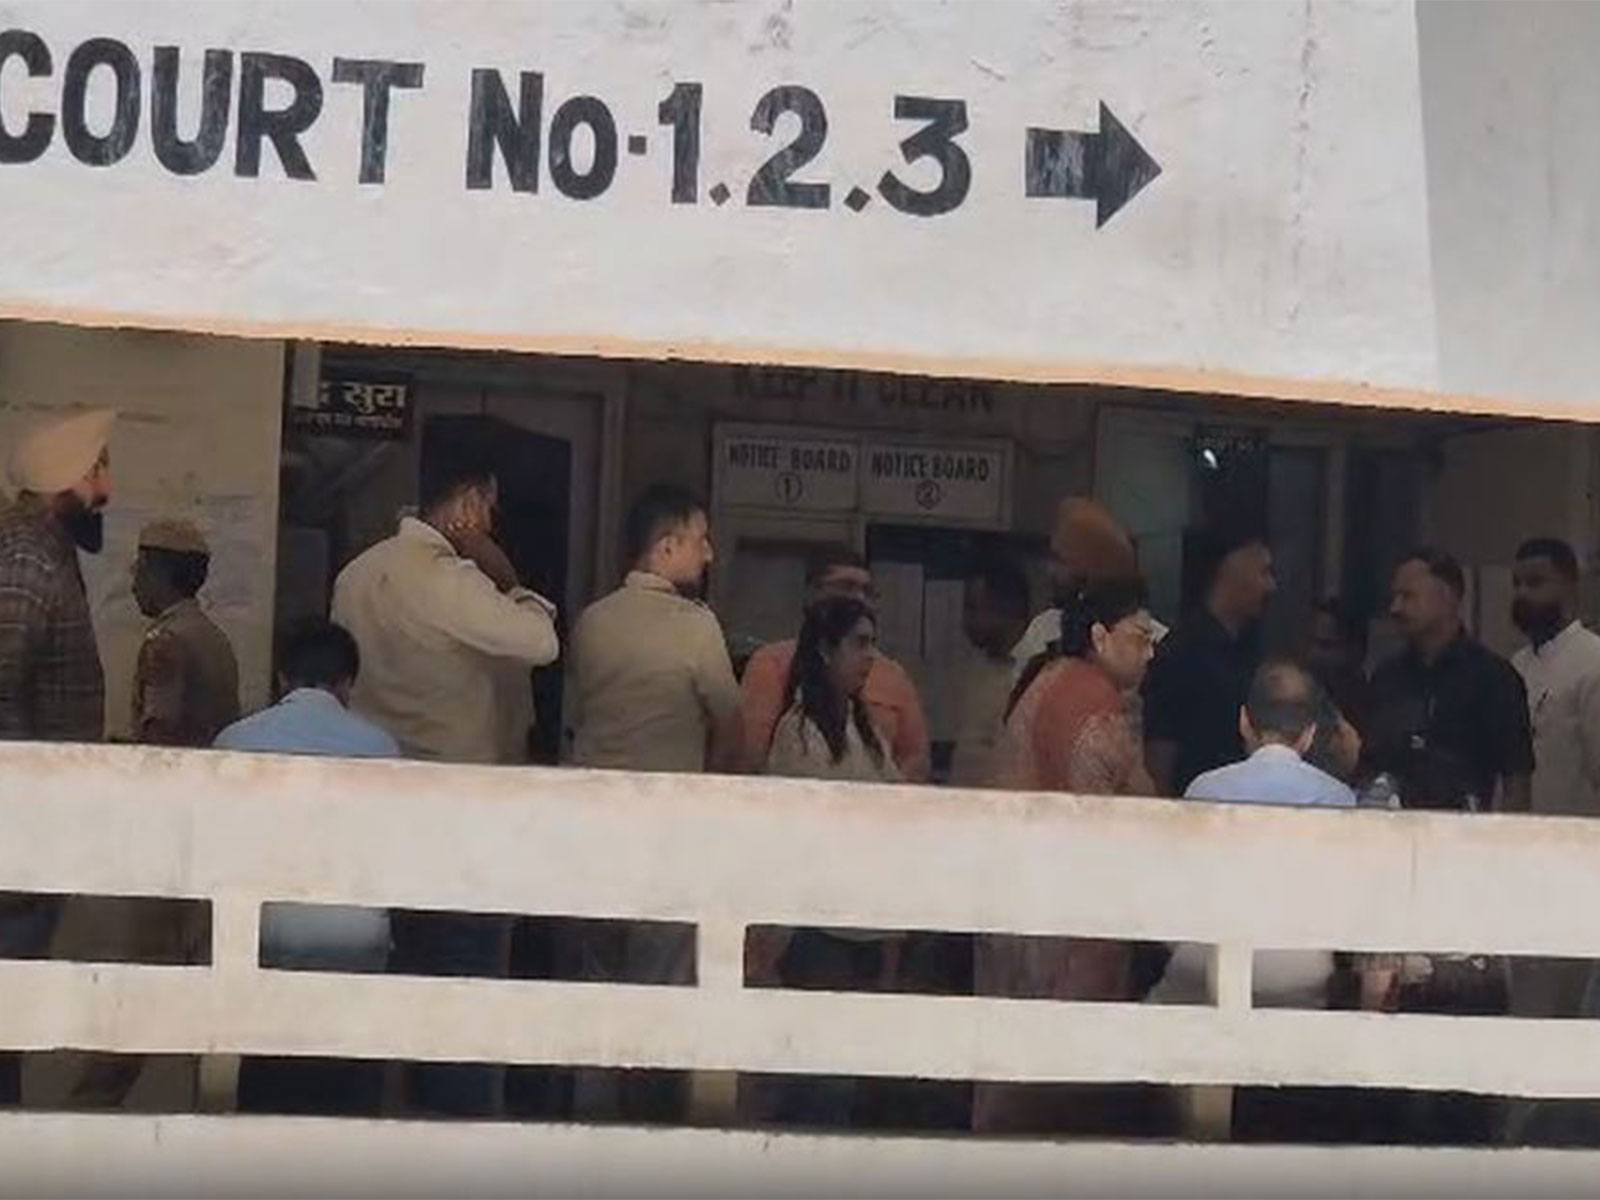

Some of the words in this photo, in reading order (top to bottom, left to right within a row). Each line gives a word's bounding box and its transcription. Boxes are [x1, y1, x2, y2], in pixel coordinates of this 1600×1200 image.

[0, 29, 425, 185] COURT
[729, 445, 779, 470] NOTICE
[790, 448, 851, 473] BOARD
[872, 451, 925, 479] NOTICE
[931, 455, 989, 482] BOARD
